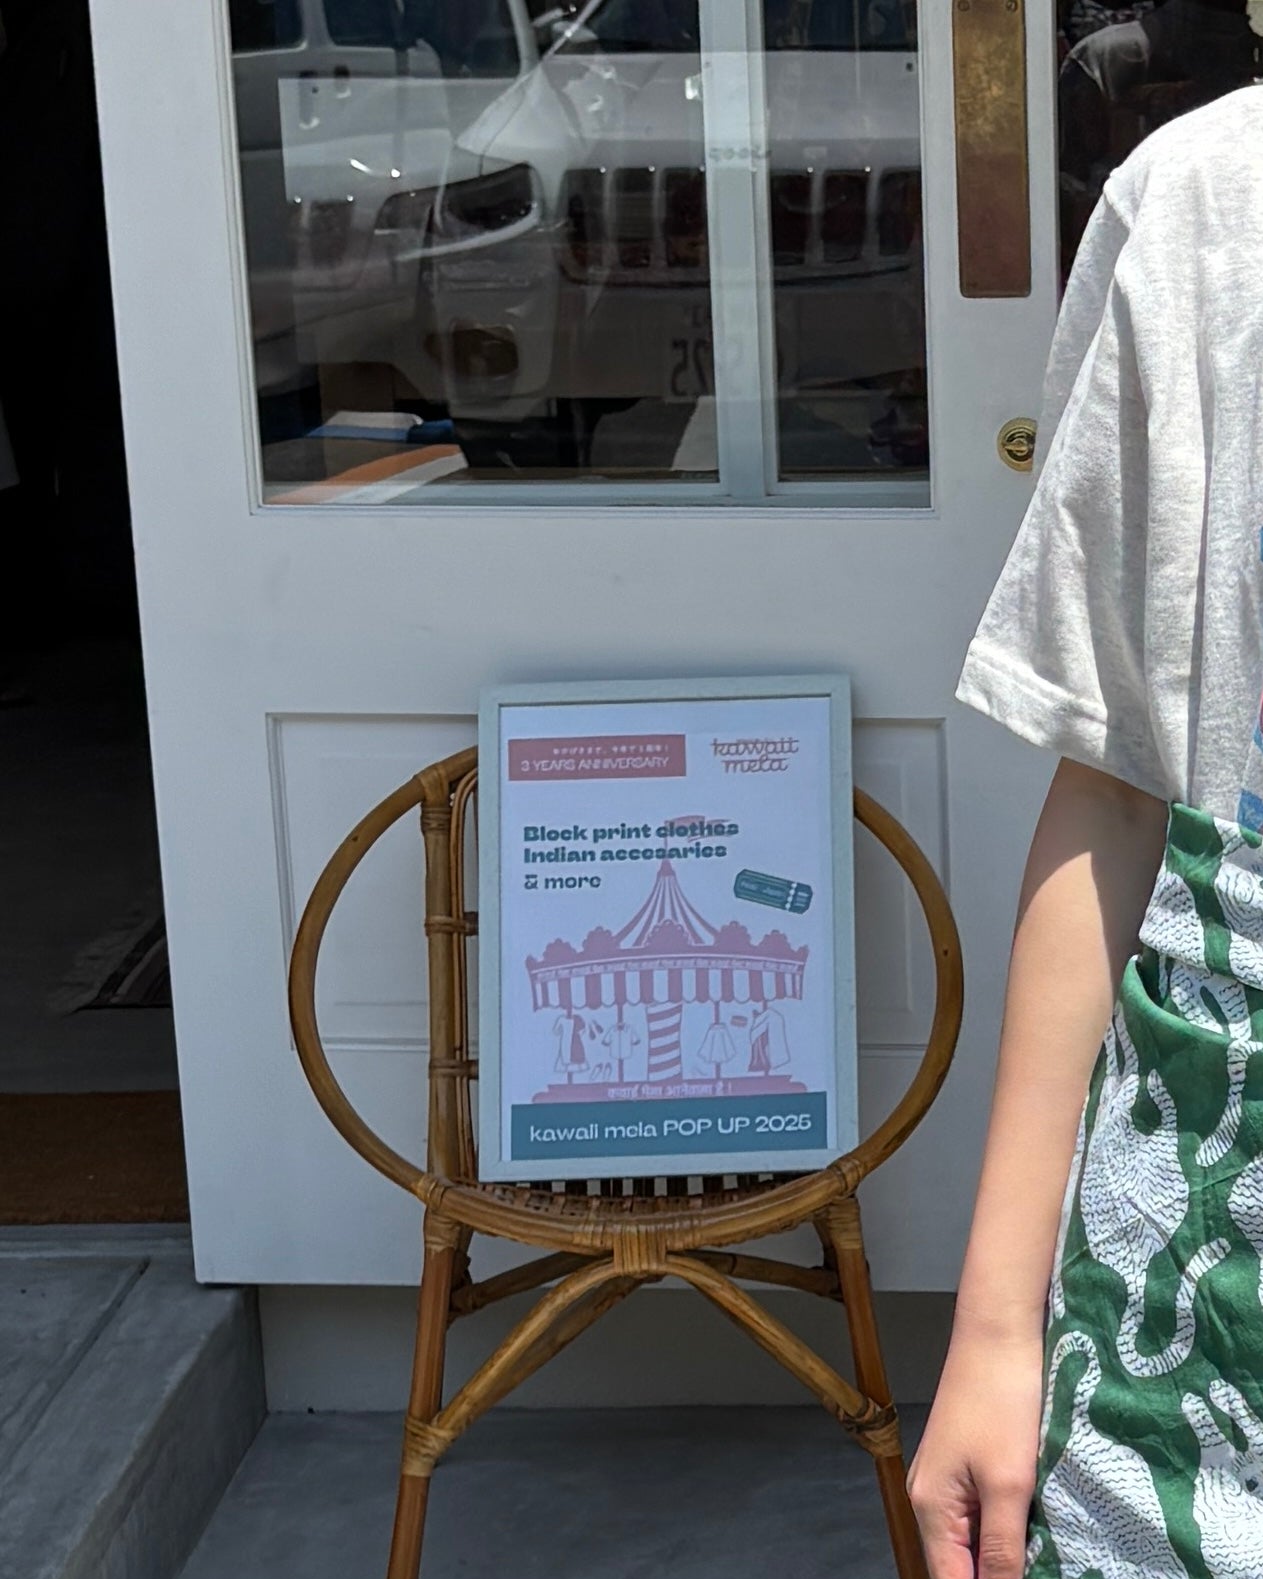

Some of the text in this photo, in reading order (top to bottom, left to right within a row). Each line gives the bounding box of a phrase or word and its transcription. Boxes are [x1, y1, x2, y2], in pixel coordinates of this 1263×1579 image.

[520, 757, 670, 772] 3 YEARS ANNIVERSARY
[523, 821, 740, 843] Block print clothes
[523, 847, 597, 863] Indian
[524, 874, 602, 889] & more
[529, 1114, 812, 1142] kawaii mela POP UP 2025
